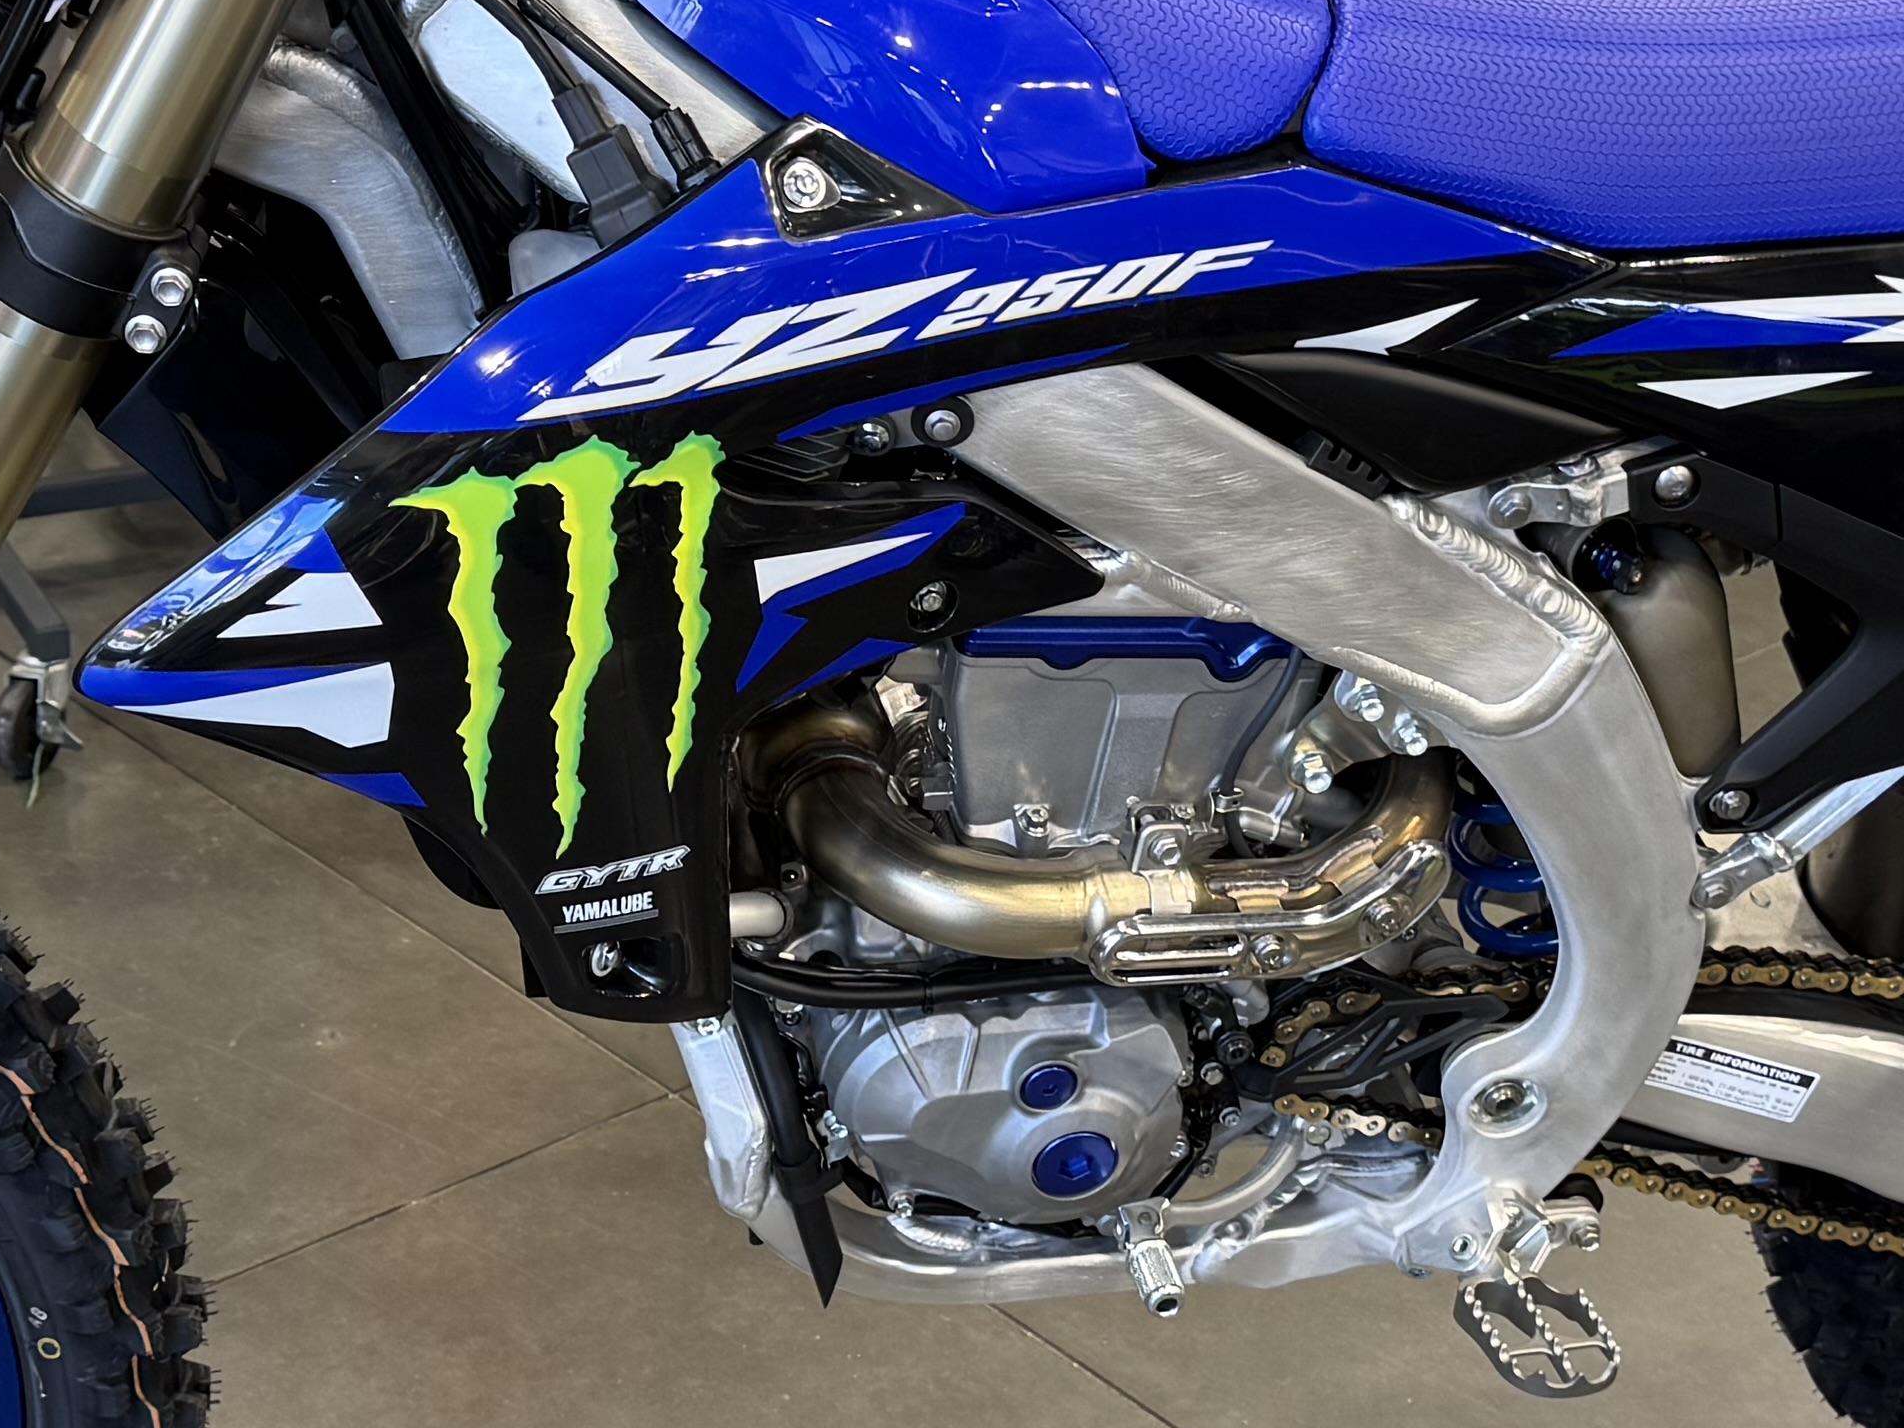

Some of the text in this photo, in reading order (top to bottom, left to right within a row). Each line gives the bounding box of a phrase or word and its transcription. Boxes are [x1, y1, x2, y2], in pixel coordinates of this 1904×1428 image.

[515, 239, 1275, 422] YZ 250F
[534, 844, 692, 895] GYTR
[561, 890, 654, 923] YAMALUBE
[1675, 1042, 1706, 1058] TIRE
[1709, 1052, 1802, 1085] INFORMATION
